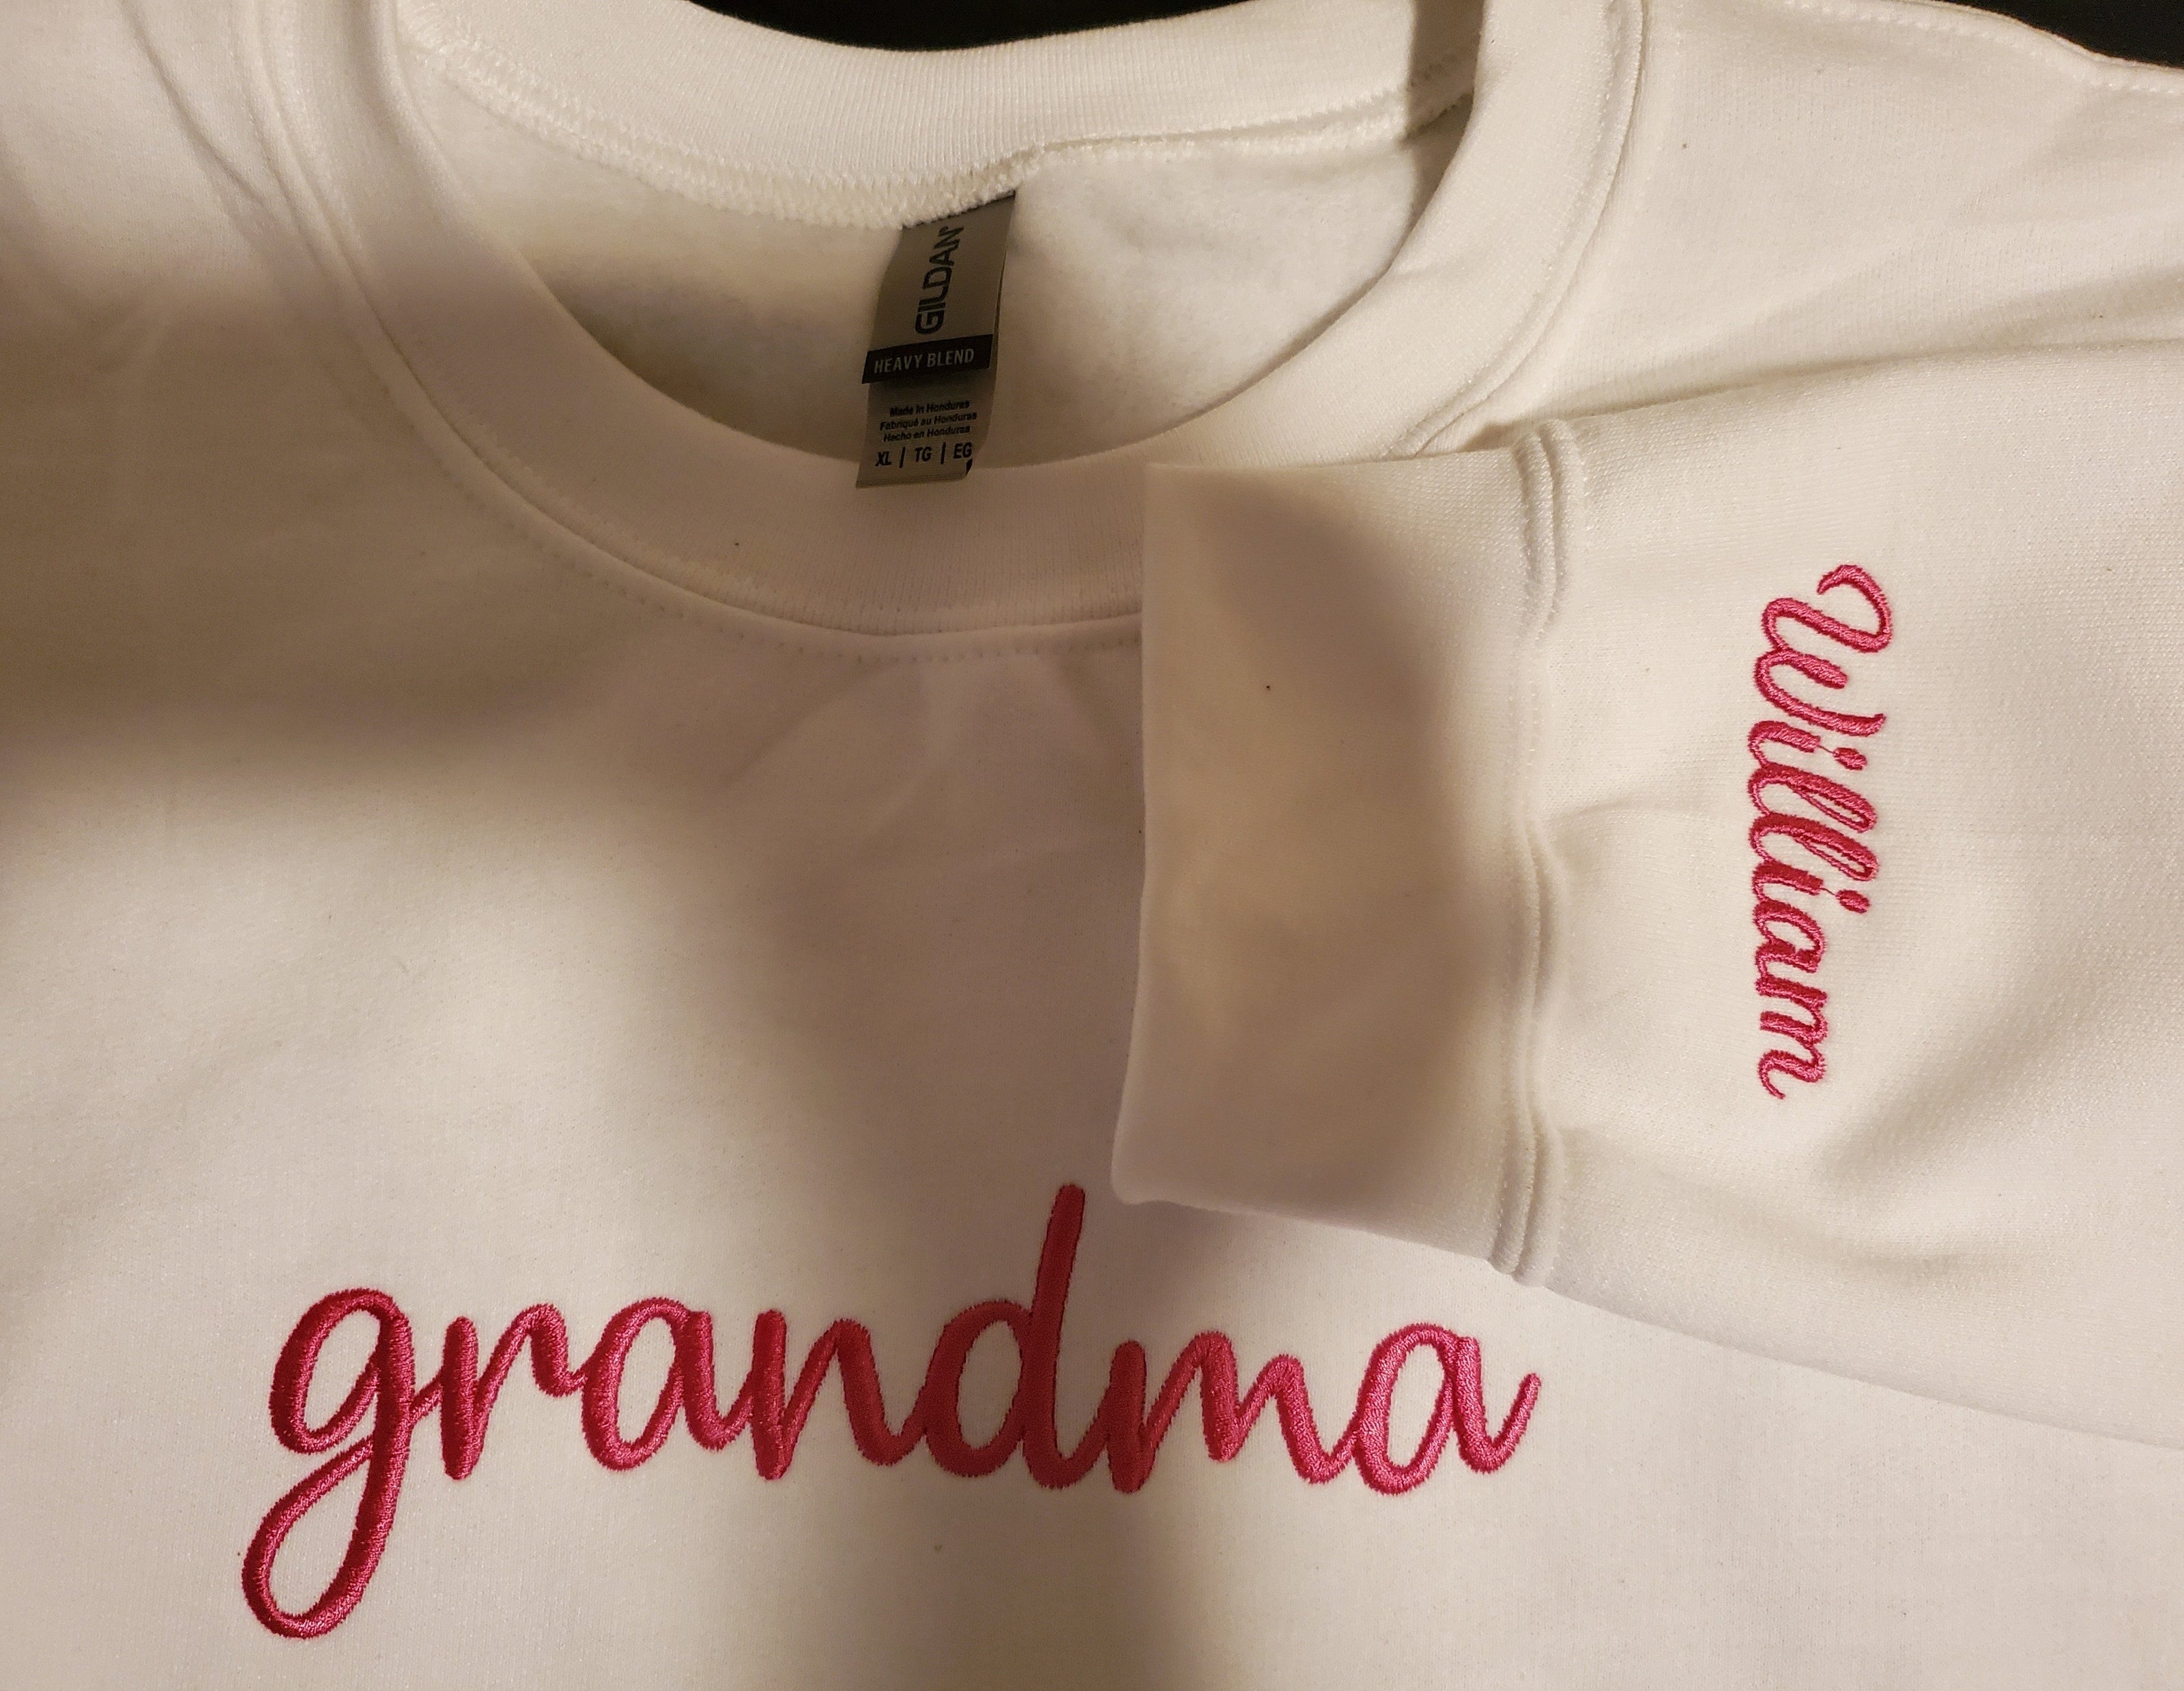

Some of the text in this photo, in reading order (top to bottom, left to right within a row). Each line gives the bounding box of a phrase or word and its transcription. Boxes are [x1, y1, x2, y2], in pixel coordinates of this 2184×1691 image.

[915, 226, 964, 334] GILDAN
[874, 348, 975, 374] HEAVY BLEND
[880, 411, 977, 431] Fabriqué au Honduras
[889, 400, 970, 418] Made in Honduras
[883, 432, 912, 442] Hecho
[926, 425, 971, 437] Honduras
[875, 442, 972, 467] XL TG EG
[1748, 564, 1894, 1100] William
[242, 1184, 1541, 1639] grandma
